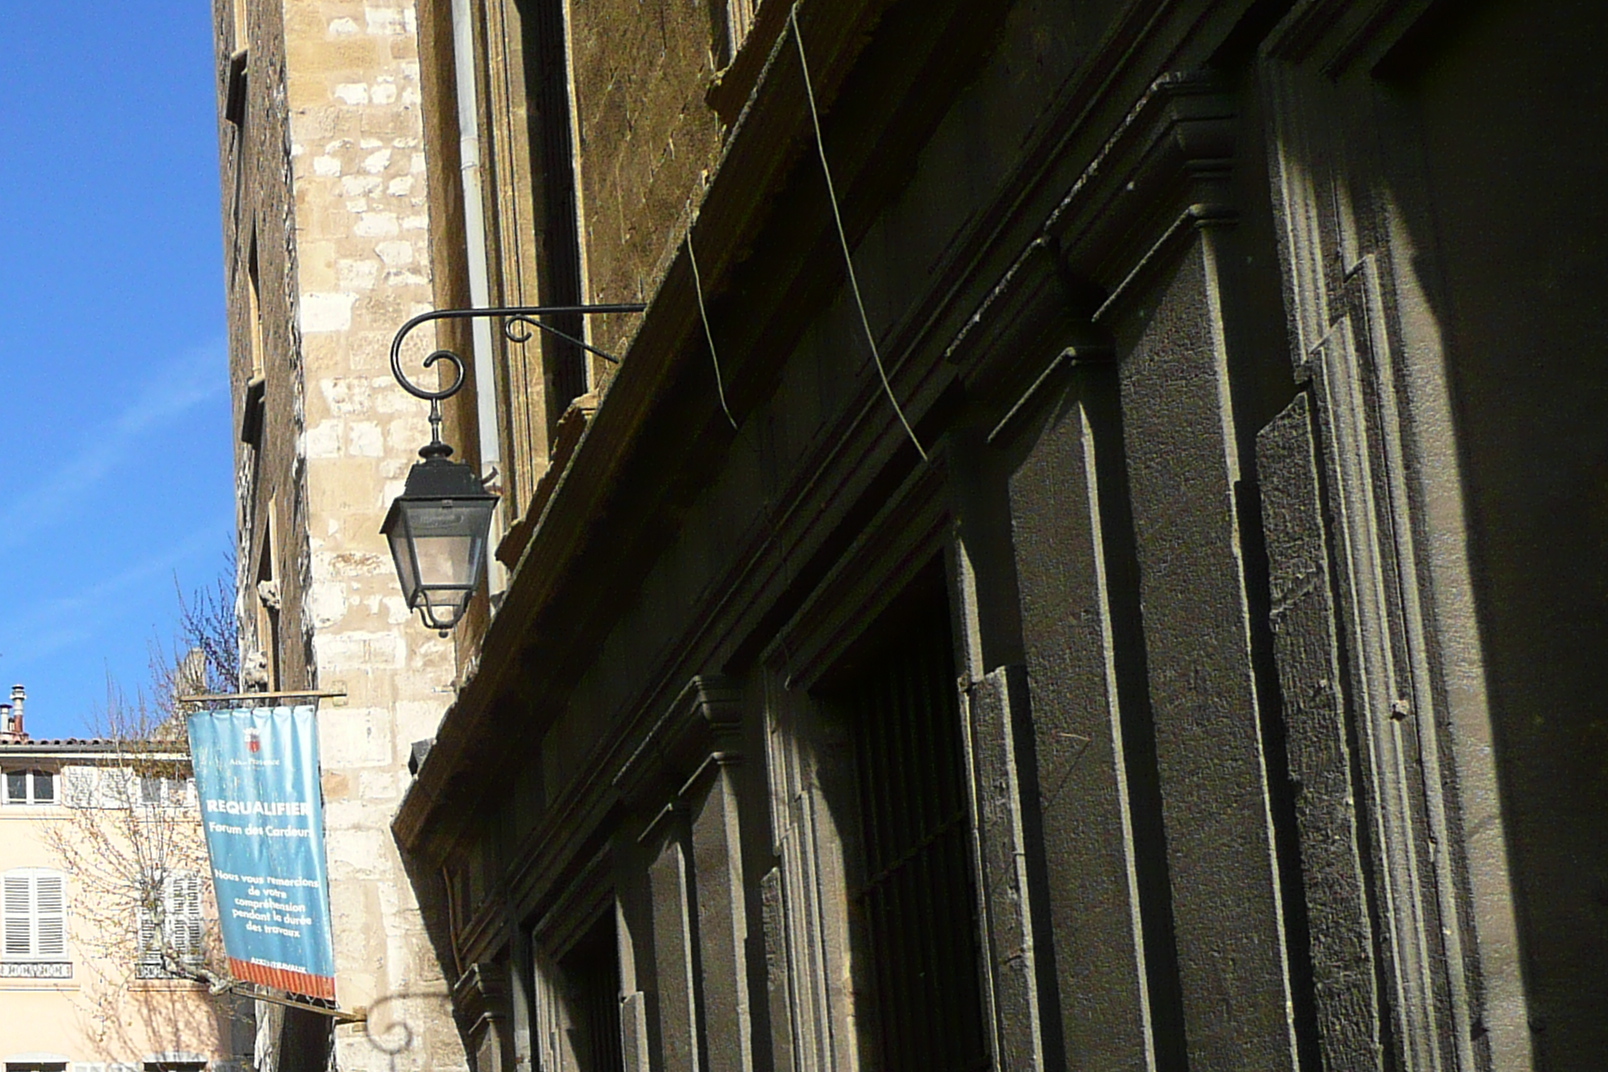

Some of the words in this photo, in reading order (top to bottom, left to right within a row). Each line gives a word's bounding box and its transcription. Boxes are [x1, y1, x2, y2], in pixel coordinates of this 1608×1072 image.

[206, 800, 311, 816] REQUALIFIER
[208, 821, 242, 835] Forum
[245, 823, 264, 836] des
[214, 869, 239, 882] Nous
[241, 875, 264, 884] vous
[267, 876, 320, 888] remercions
[248, 885, 260, 896] de
[263, 888, 287, 899] votre
[234, 898, 306, 913] compréhension
[232, 909, 271, 922] pendant
[273, 911, 282, 922] la
[283, 913, 313, 925] durée
[246, 920, 262, 932] des
[264, 925, 301, 938] travaux
